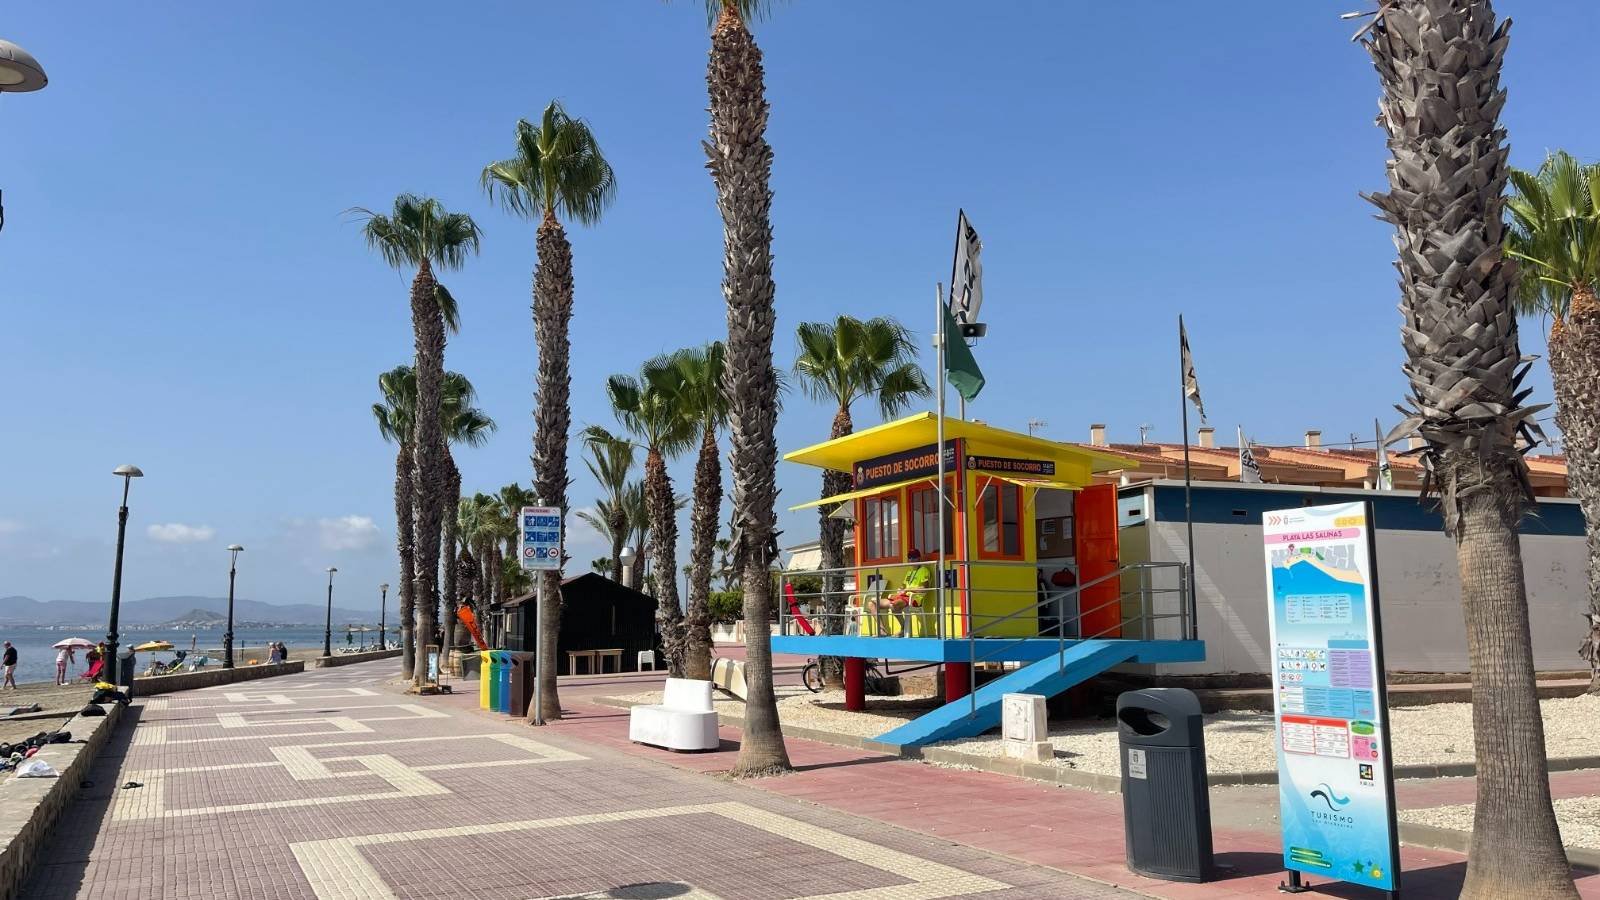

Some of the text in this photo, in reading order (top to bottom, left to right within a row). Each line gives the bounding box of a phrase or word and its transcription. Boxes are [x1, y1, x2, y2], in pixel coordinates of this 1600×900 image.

[866, 465, 892, 479] PUESTO
[893, 462, 903, 473] DE
[904, 453, 940, 471] SOCORRO
[978, 459, 1002, 469] PUESTO
[1003, 461, 1012, 469] DE
[1013, 462, 1041, 471] SOCORRO
[1315, 530, 1342, 539] SALINAS
[1311, 810, 1353, 823] TURISMO
